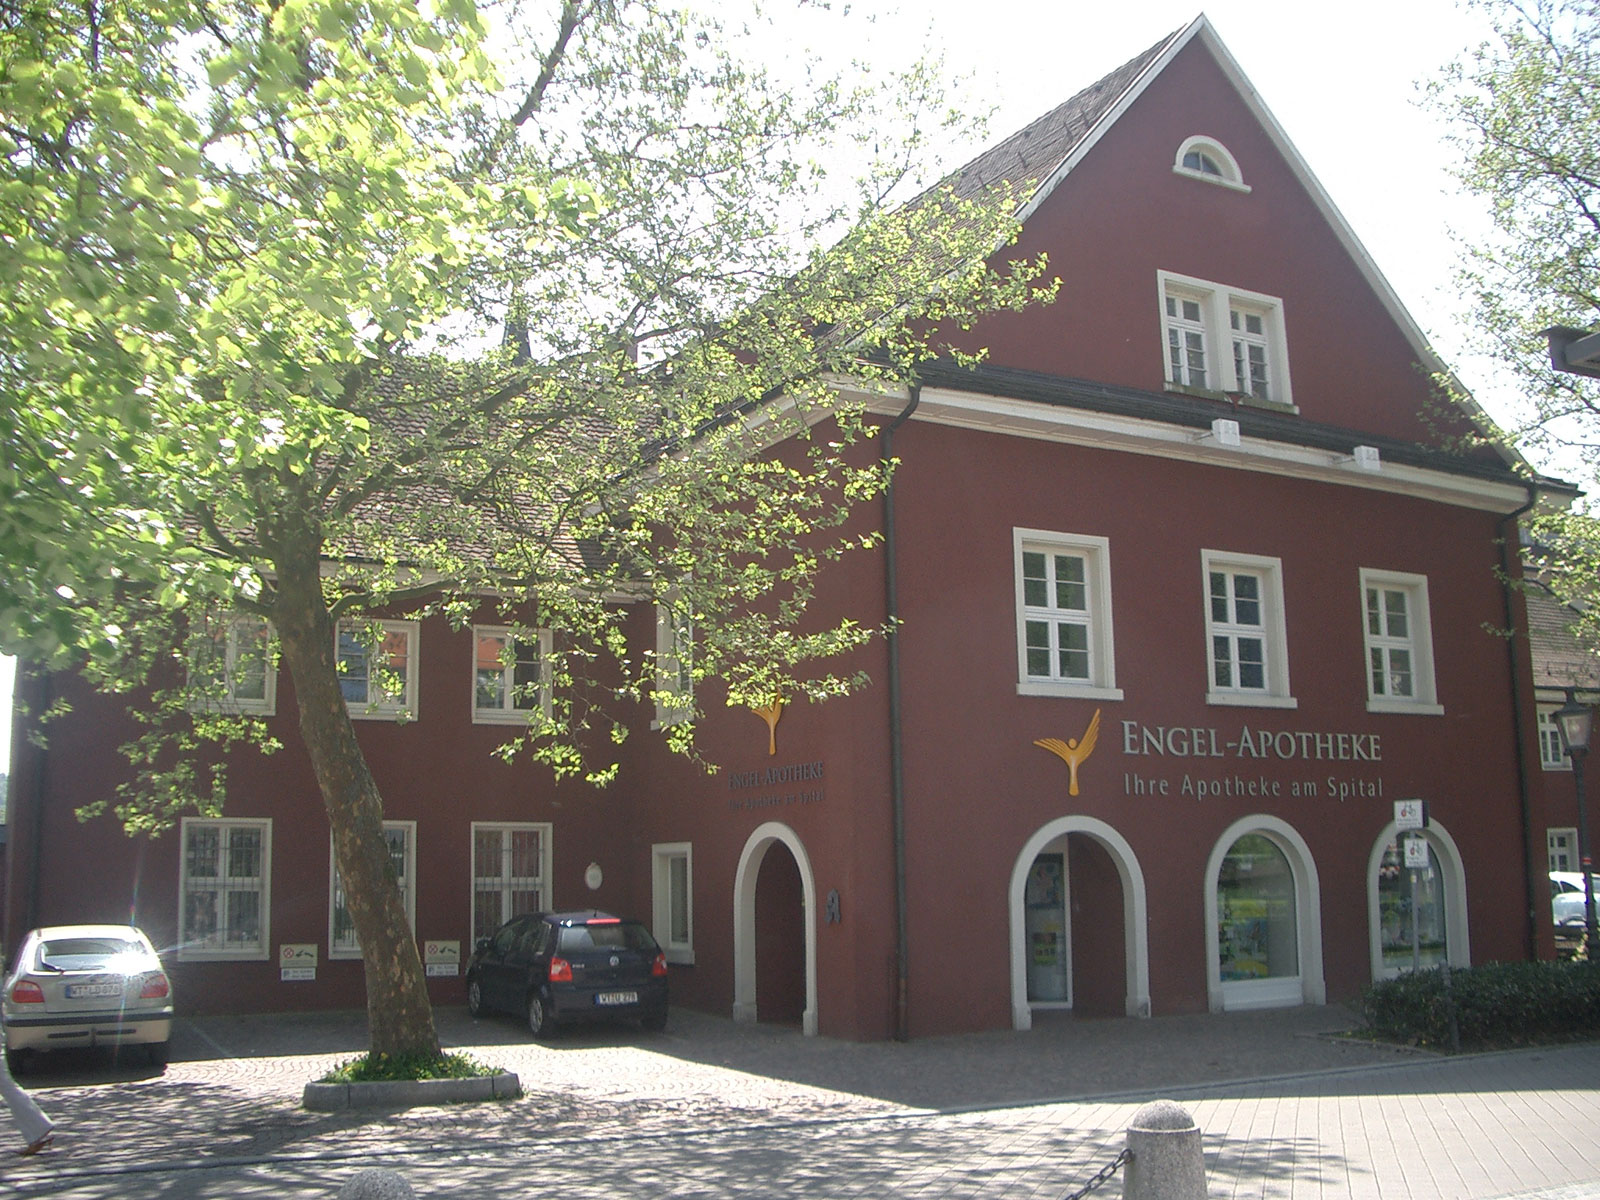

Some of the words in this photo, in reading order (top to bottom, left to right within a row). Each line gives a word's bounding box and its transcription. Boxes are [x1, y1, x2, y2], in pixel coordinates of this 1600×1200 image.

[1121, 720, 1382, 761] ENGEL-APOTHEKE
[1124, 773, 1169, 796] Ihre
[1181, 774, 1281, 800] Apotheke
[1291, 780, 1317, 797] am
[1327, 776, 1383, 802] Spital
